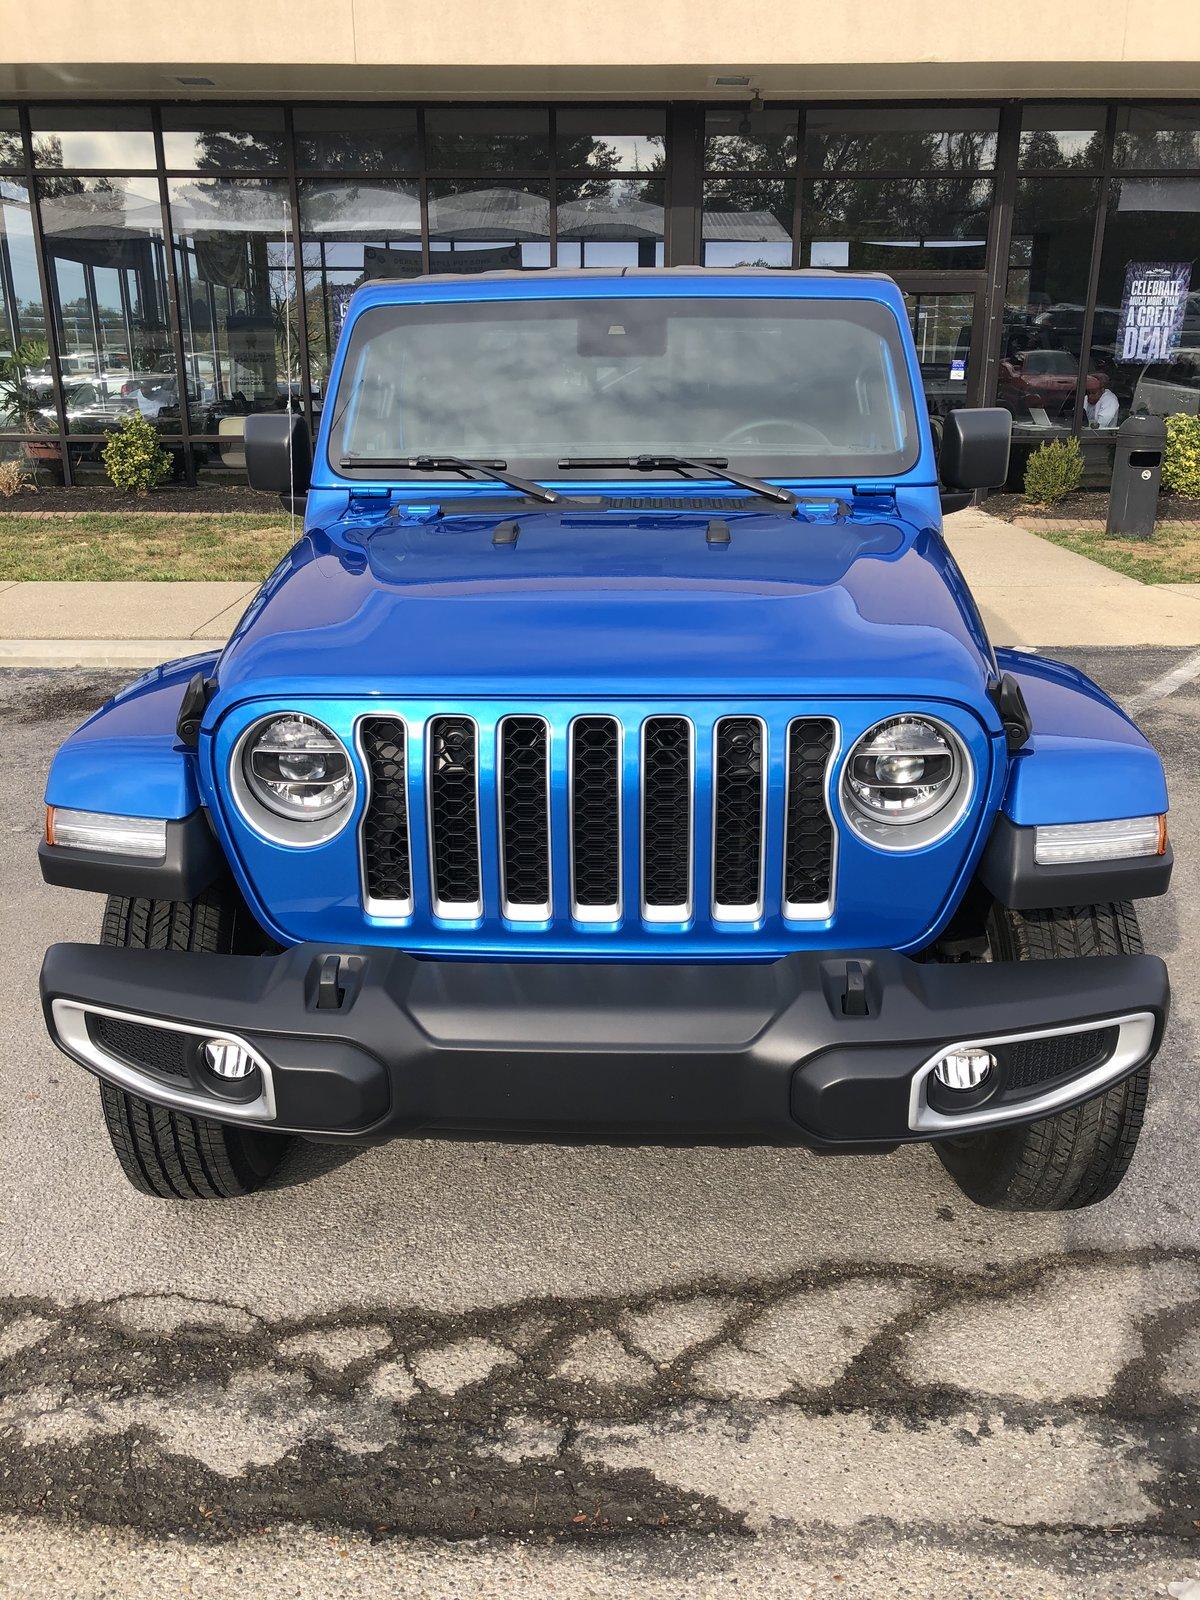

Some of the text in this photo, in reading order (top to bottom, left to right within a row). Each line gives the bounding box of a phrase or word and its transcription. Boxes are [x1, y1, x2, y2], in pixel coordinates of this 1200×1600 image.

[1131, 280, 1182, 296] CELEBRATE
[1129, 296, 1180, 306] MUCH MORE THAN
[1126, 306, 1179, 327] A GREAT
[1122, 327, 1170, 360] DEAL
